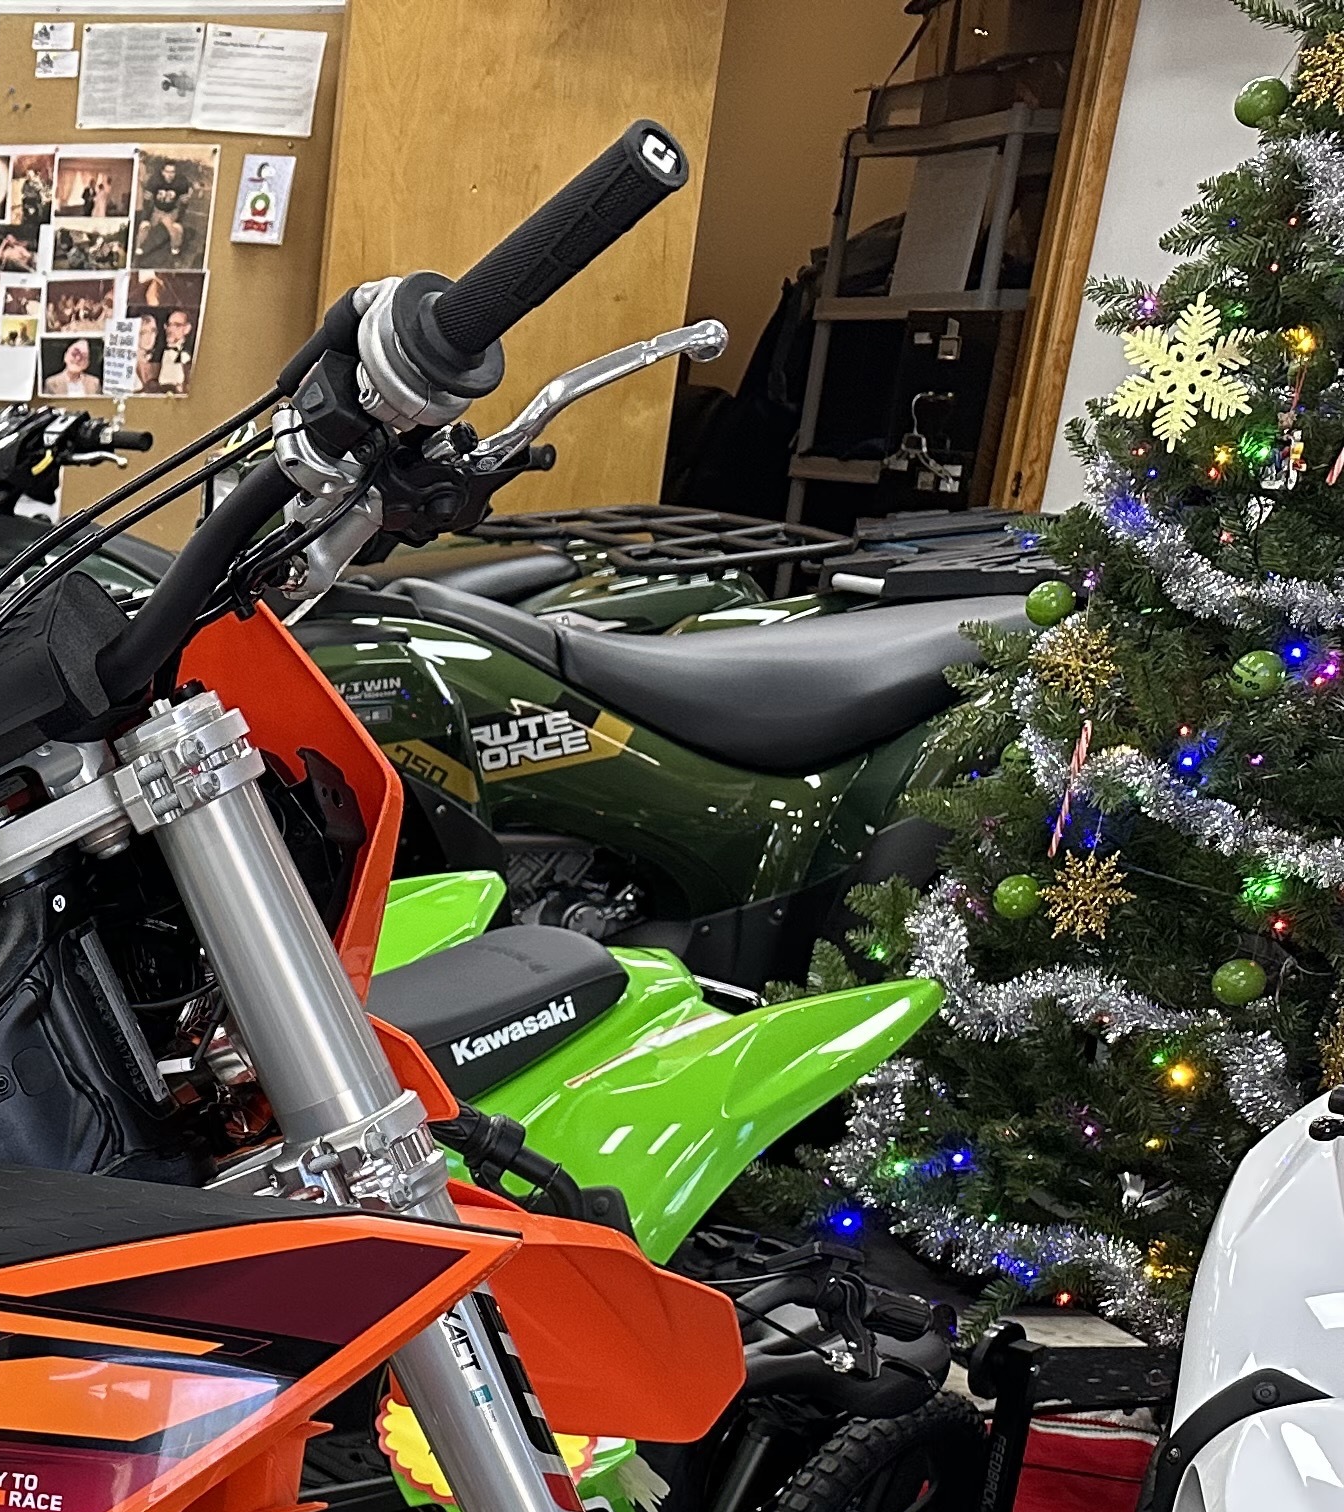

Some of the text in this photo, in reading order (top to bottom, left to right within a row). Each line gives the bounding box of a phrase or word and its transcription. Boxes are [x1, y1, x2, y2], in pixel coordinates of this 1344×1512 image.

[334, 676, 403, 694] V-TWIN
[470, 710, 574, 747] RUTE
[394, 744, 449, 786] 750
[476, 729, 591, 771] ORCE
[450, 996, 578, 1067] Kawasaki
[11, 1473, 39, 1491] TO
[982, 1434, 1007, 1509] FEEDBACK
[8, 1490, 63, 1512] RACE
